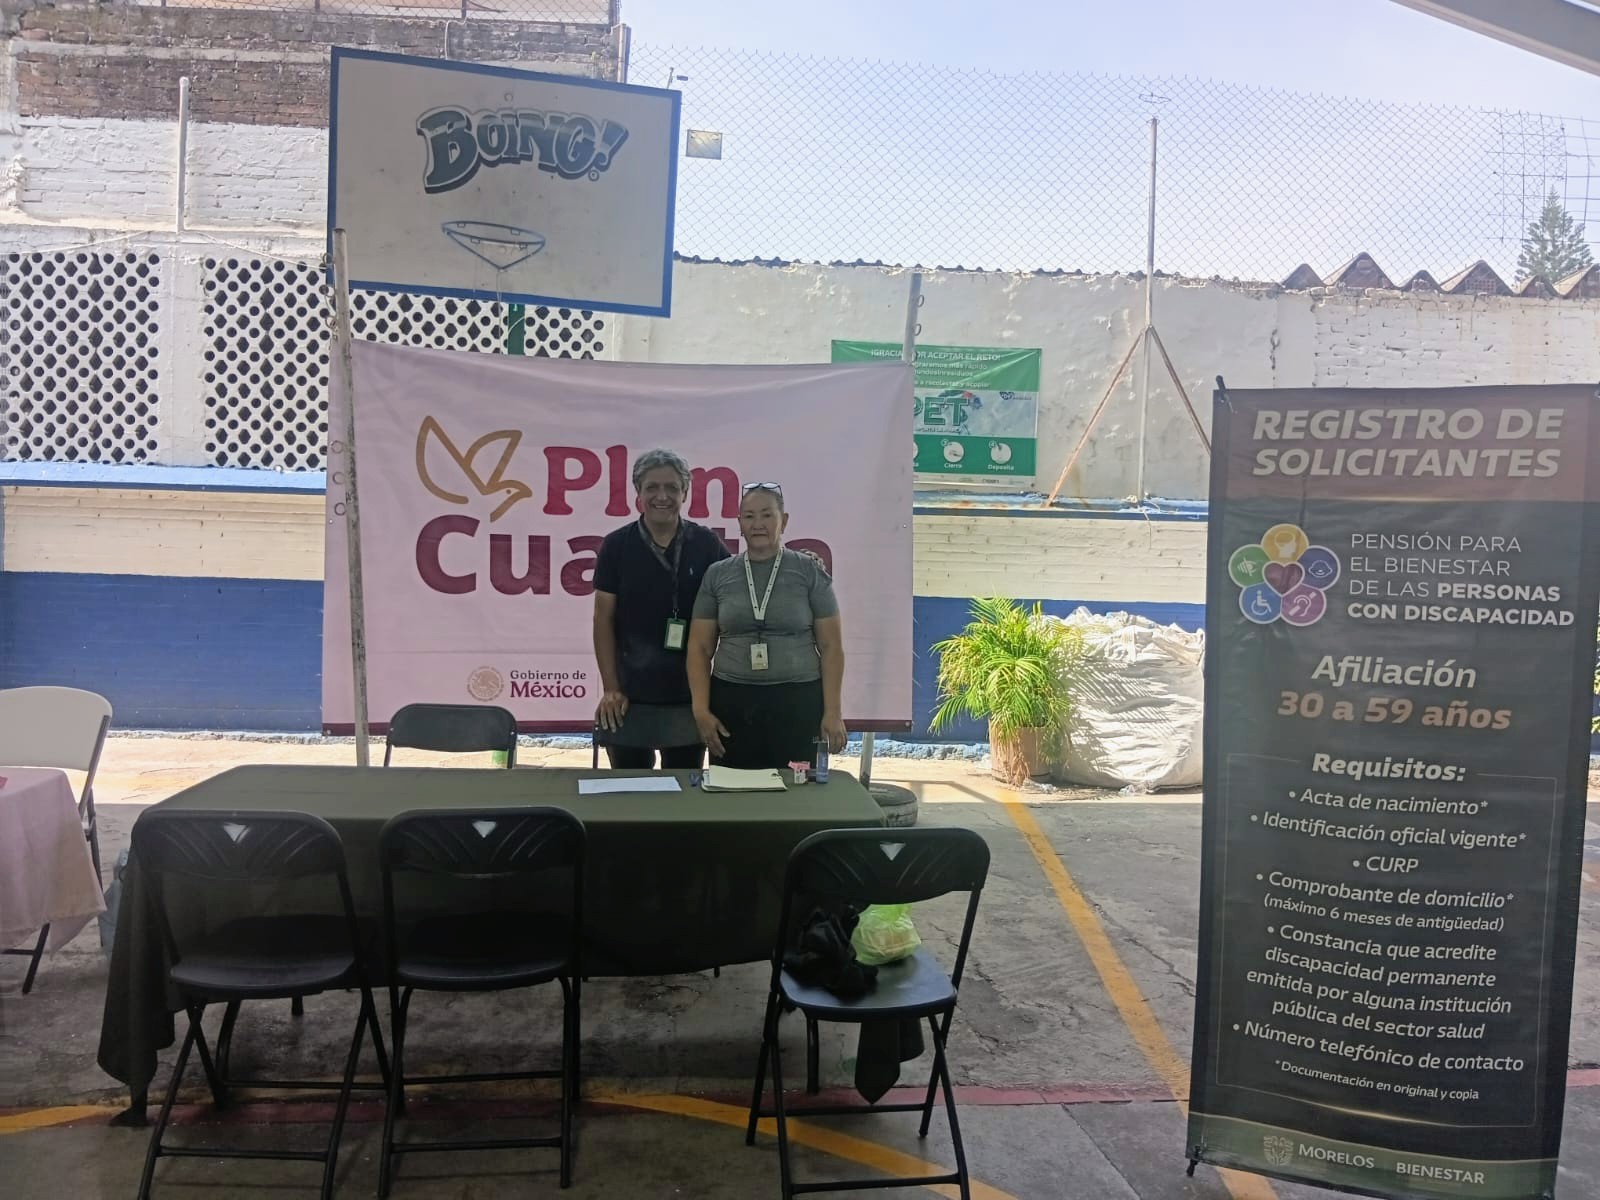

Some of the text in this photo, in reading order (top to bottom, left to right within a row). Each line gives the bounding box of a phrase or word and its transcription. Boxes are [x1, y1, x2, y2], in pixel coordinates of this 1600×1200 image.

[416, 105, 630, 194] BOING!
[871, 348, 903, 358] ¡GRACIA
[928, 351, 964, 360] ACEPTAR
[967, 352, 976, 361] EL
[1252, 408, 1565, 440] REGISTRO DE
[1252, 448, 1561, 477] SOLICITANTES
[542, 444, 741, 519] Pln
[1351, 531, 1522, 553] PENSIÓN PARA
[1351, 557, 1510, 577] EL BIENESTAR
[1350, 580, 1561, 602] DE LAS PERSONAS
[1347, 603, 1575, 626] CON DISCAPACIDAD
[510, 670, 587, 680] Gobierno de
[1312, 655, 1477, 688] Afiliación
[510, 680, 586, 698] México
[1277, 691, 1512, 729] 30 a 59 años
[1312, 753, 1466, 781] Requisitos:
[1300, 788, 1344, 808] Acta
[1349, 793, 1371, 810] de
[1262, 811, 1385, 841] Identificación
[1390, 825, 1446, 847] oficial
[1366, 856, 1419, 873] CURP
[1268, 871, 1393, 904] Comprobante
[1398, 887, 1421, 905] de
[1263, 892, 1505, 932] (máximo 6 meses de antigüedad)
[1280, 924, 1497, 961] Constancia que acredite
[1265, 946, 1496, 988] discapacidad permanente
[1246, 969, 1512, 1014] emitida por alguna institución
[1272, 1000, 1485, 1040] pública del sector salud
[1244, 1020, 1524, 1072] Número telefónico de contacto
[1376, 1082, 1391, 1092] en
[1393, 1084, 1438, 1098] original
[1440, 1090, 1449, 1100] y
[1449, 1089, 1480, 1101] copia
[1298, 1143, 1485, 1185] MORELOS BIENESTAR
